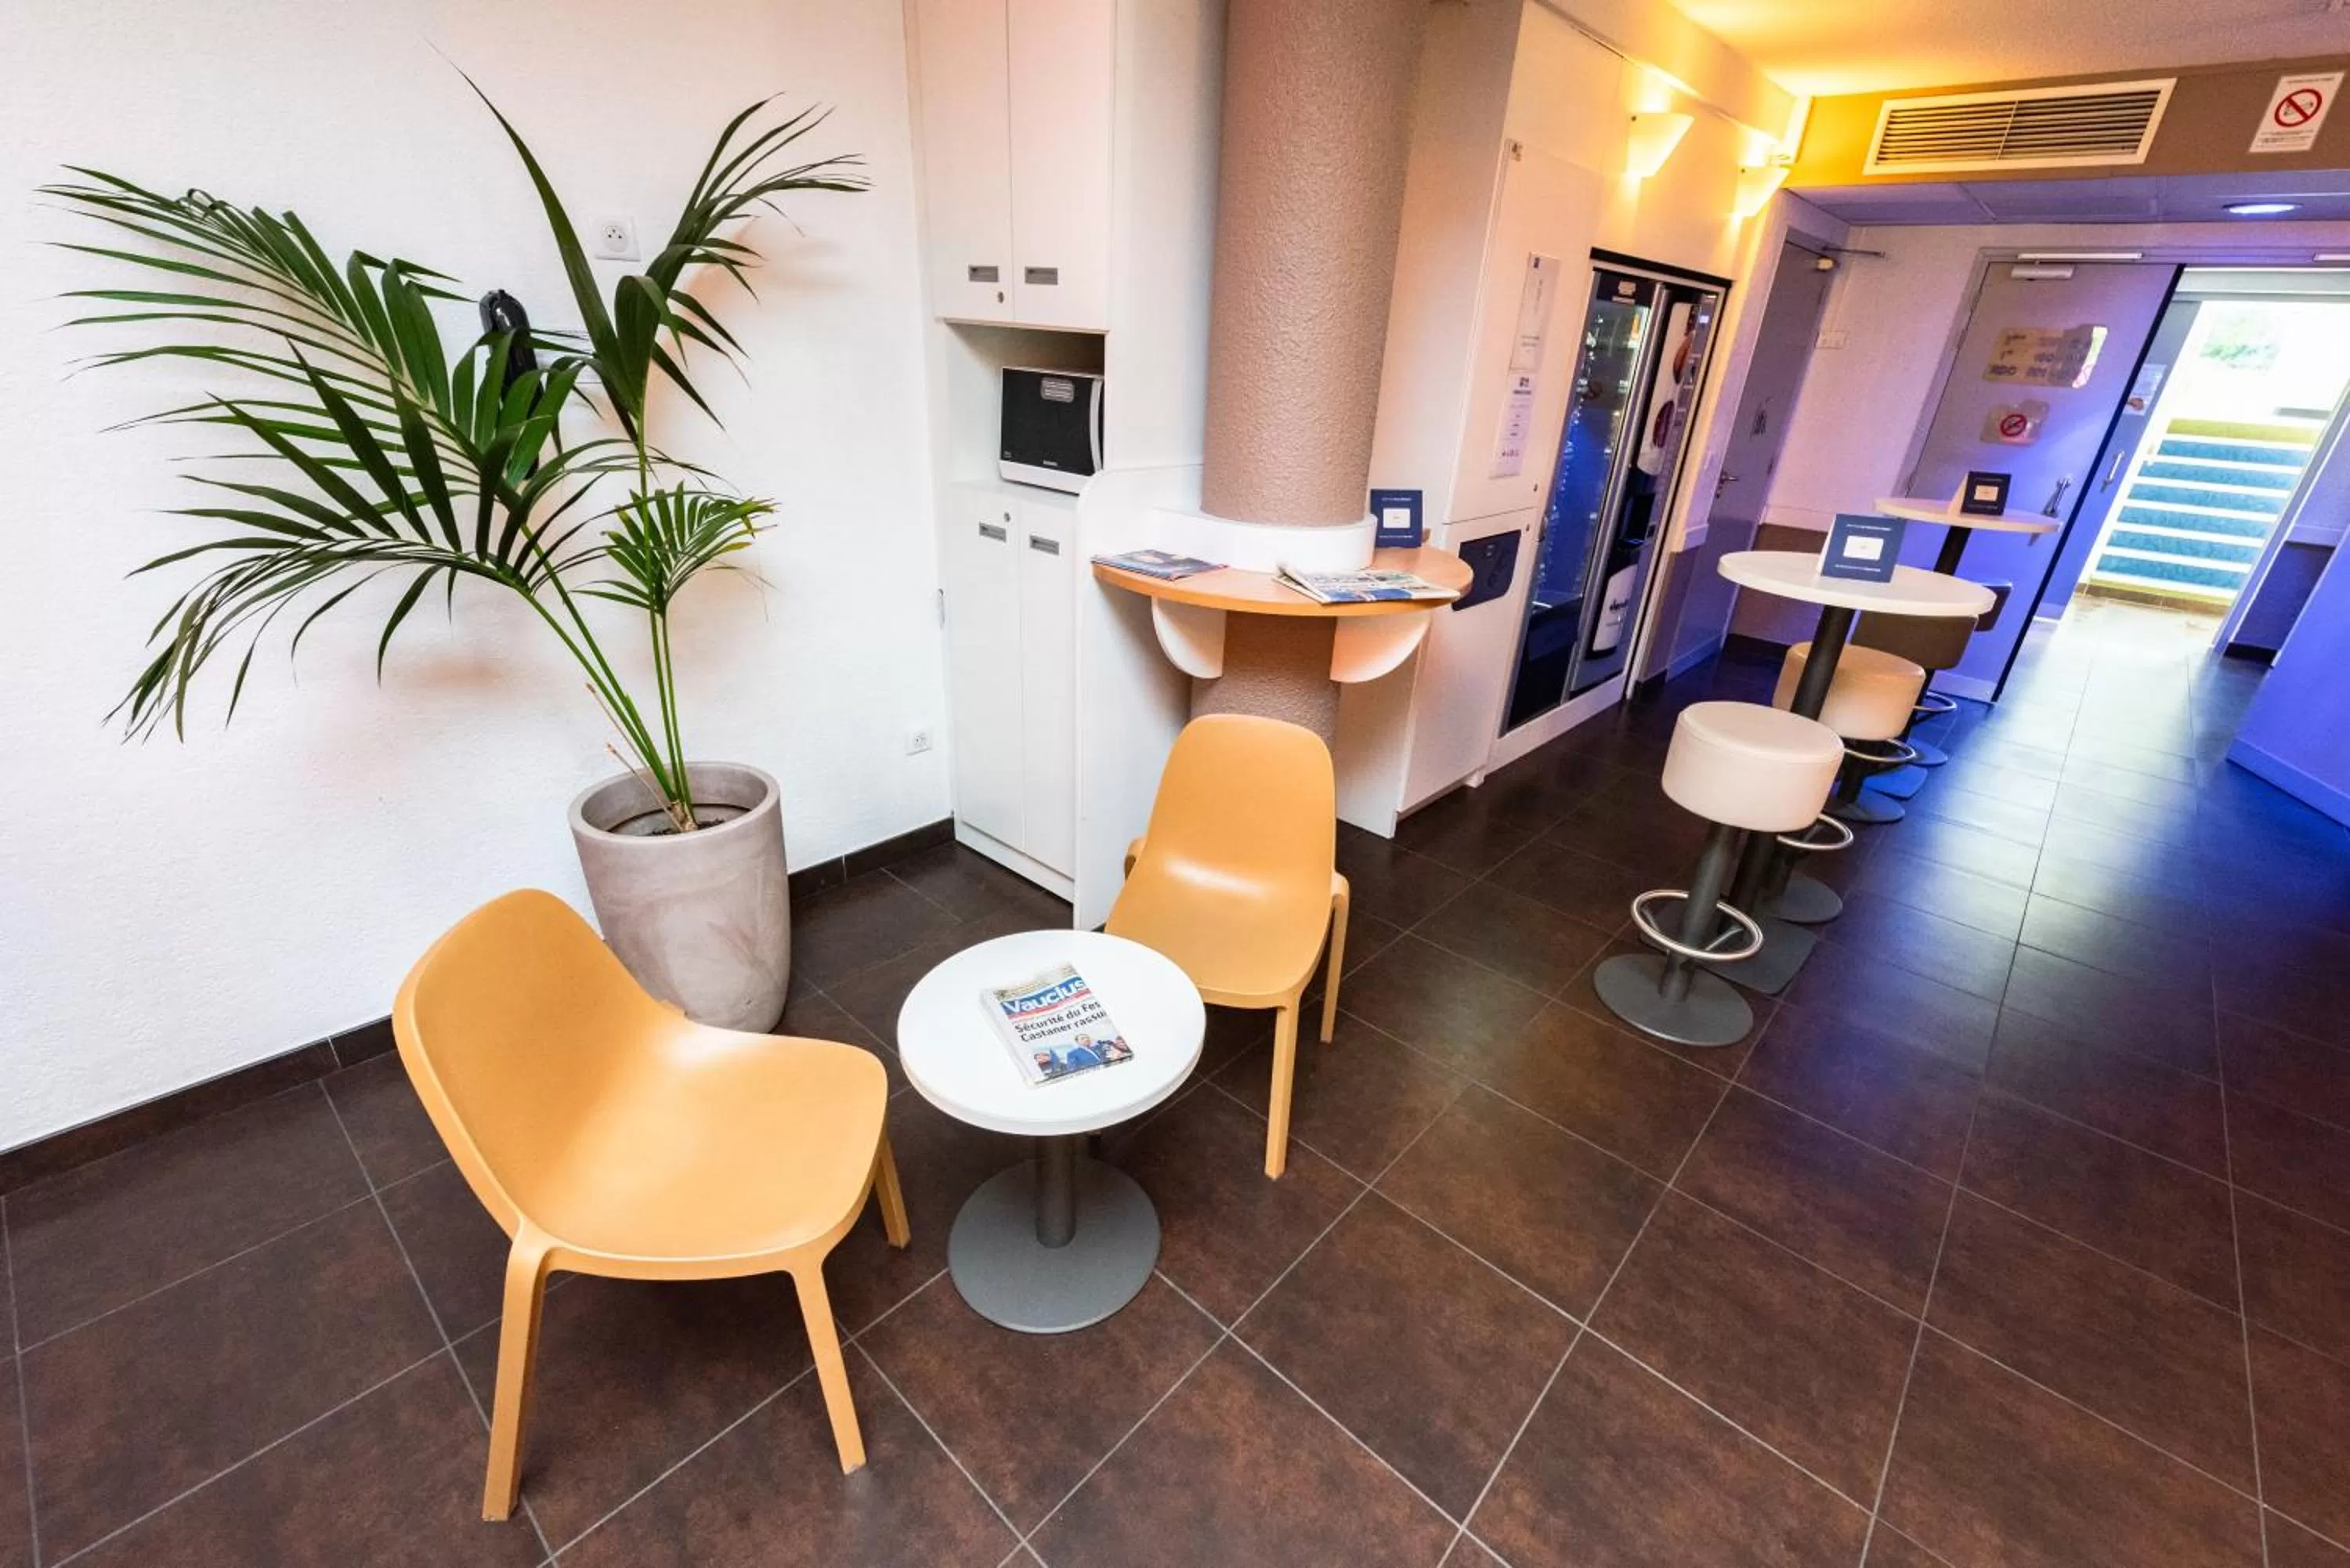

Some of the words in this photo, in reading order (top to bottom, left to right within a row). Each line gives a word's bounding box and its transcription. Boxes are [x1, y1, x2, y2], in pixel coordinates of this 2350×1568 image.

[1015, 1014, 1065, 1033] Sécurité
[1066, 1007, 1080, 1019] du
[1021, 1024, 1072, 1042] Castaner
